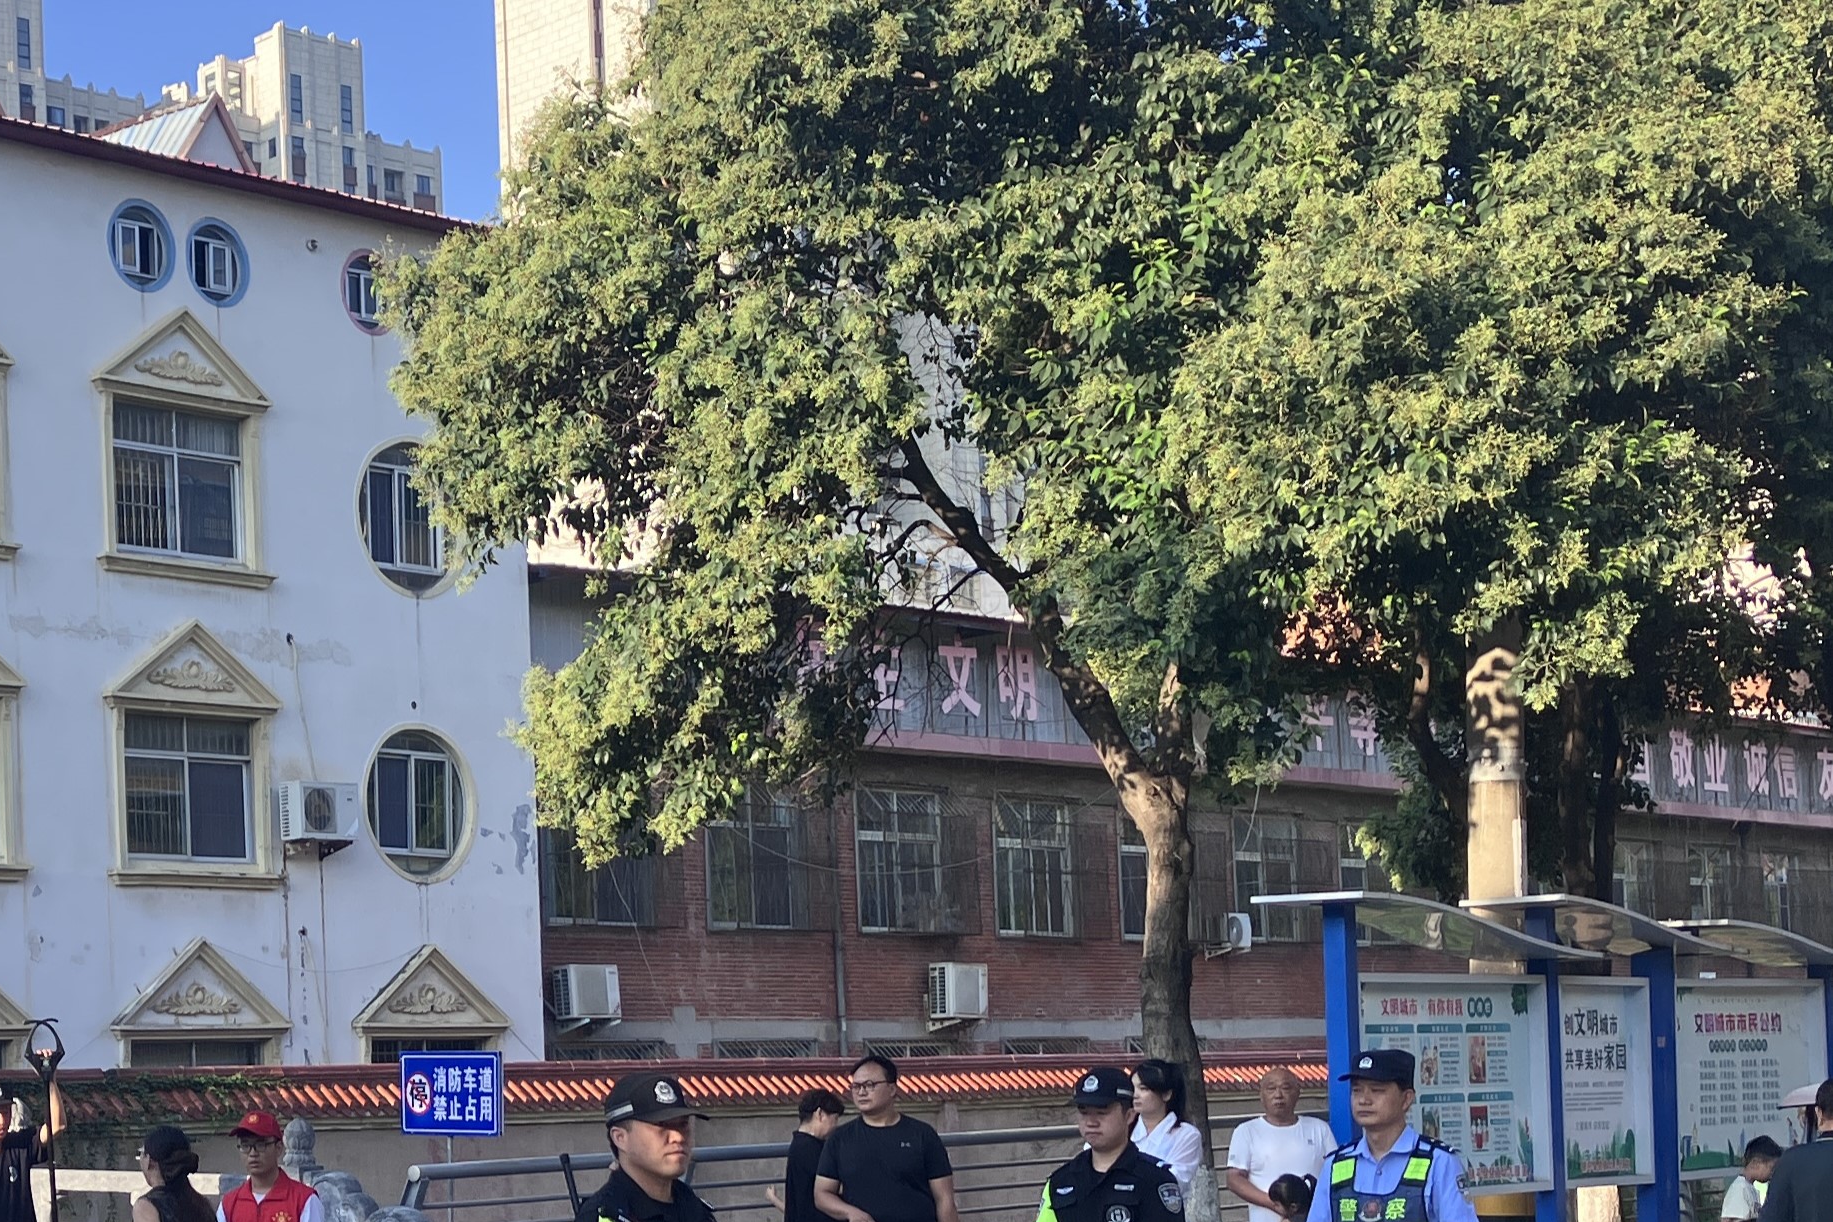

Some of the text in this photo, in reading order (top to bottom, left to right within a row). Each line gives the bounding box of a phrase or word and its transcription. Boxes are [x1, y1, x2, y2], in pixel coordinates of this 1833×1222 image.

[938, 633, 1038, 722] 文明
[1669, 727, 1729, 792] 敬业
[1743, 740, 1798, 799] 诚信
[1564, 1008, 1618, 1036] 创文明城市
[1694, 1012, 1782, 1033] 文明城市市民公约
[1565, 1043, 1626, 1070] 共享美好家园
[433, 1066, 493, 1093] 消防车道
[433, 1095, 493, 1121] 禁止占用
[1339, 1198, 1407, 1222] 警察
